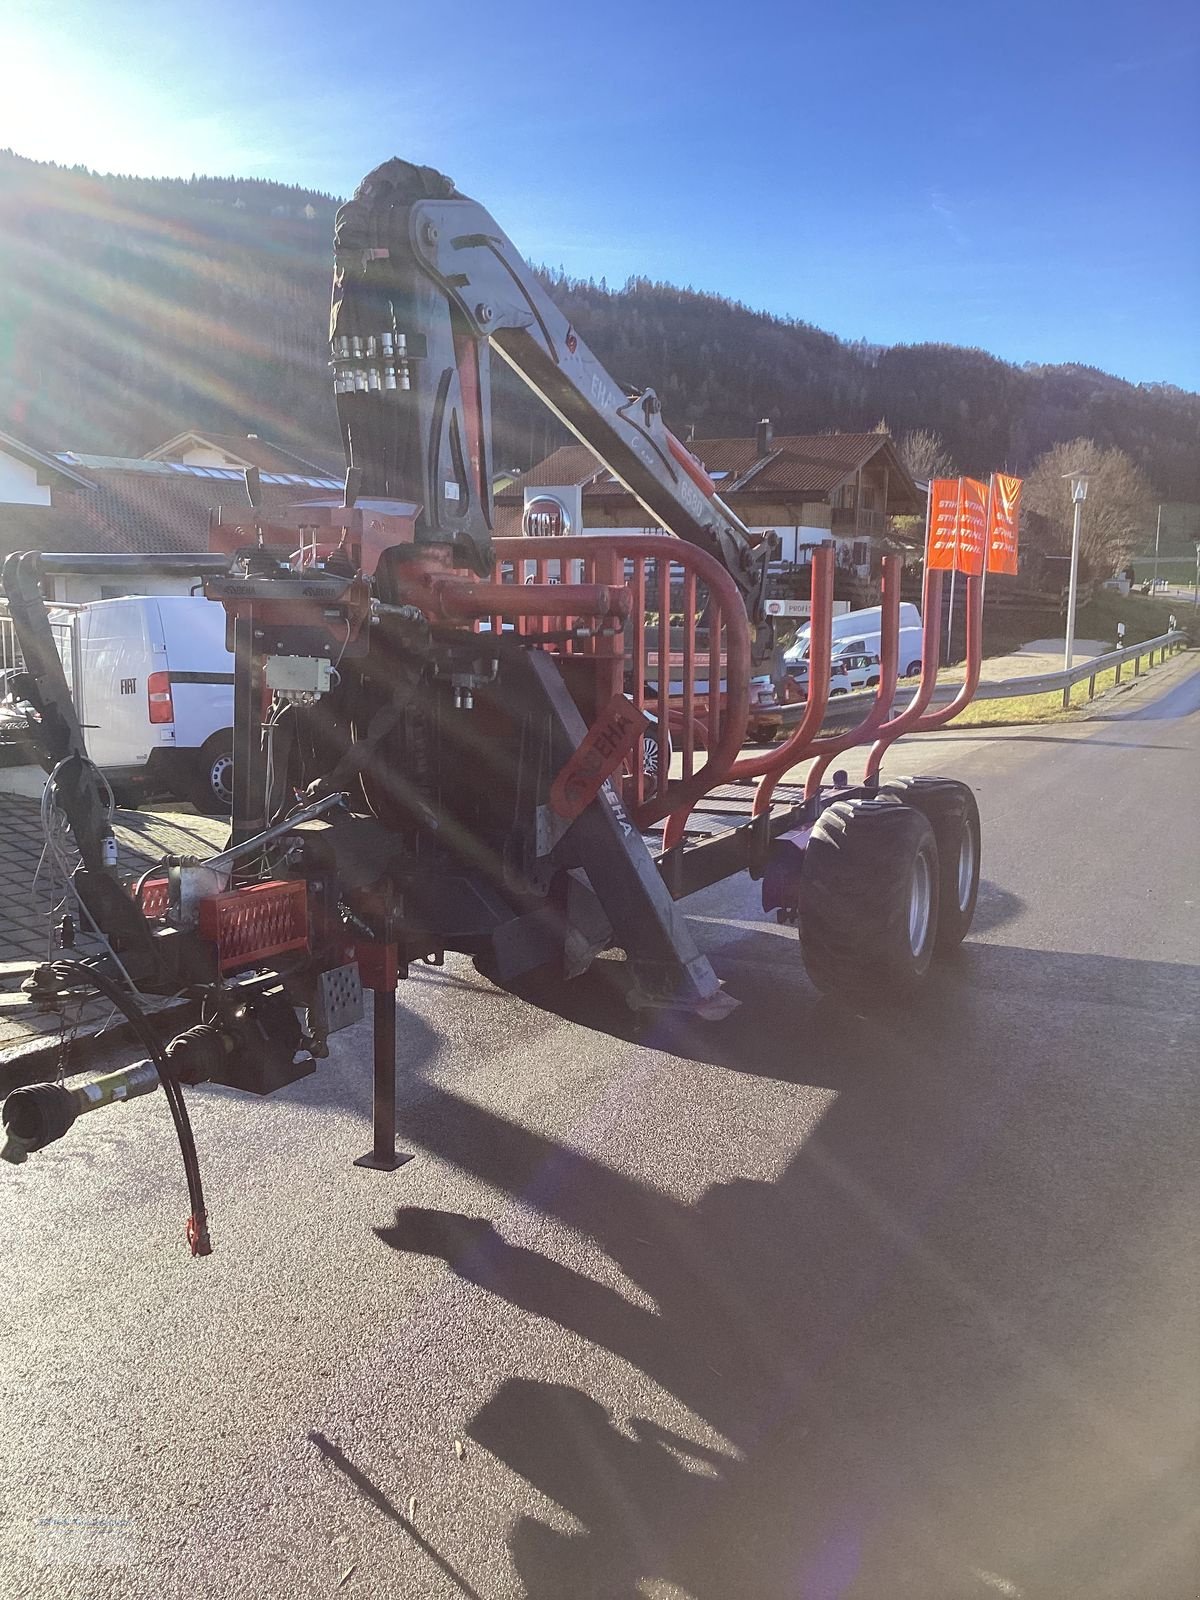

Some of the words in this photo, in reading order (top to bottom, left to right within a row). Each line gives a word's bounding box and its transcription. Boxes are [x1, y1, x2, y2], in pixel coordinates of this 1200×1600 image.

[939, 500, 959, 508] STIH
[937, 514, 958, 522] STIH
[934, 541, 956, 550] STIH
[120, 677, 137, 695] FIAT
